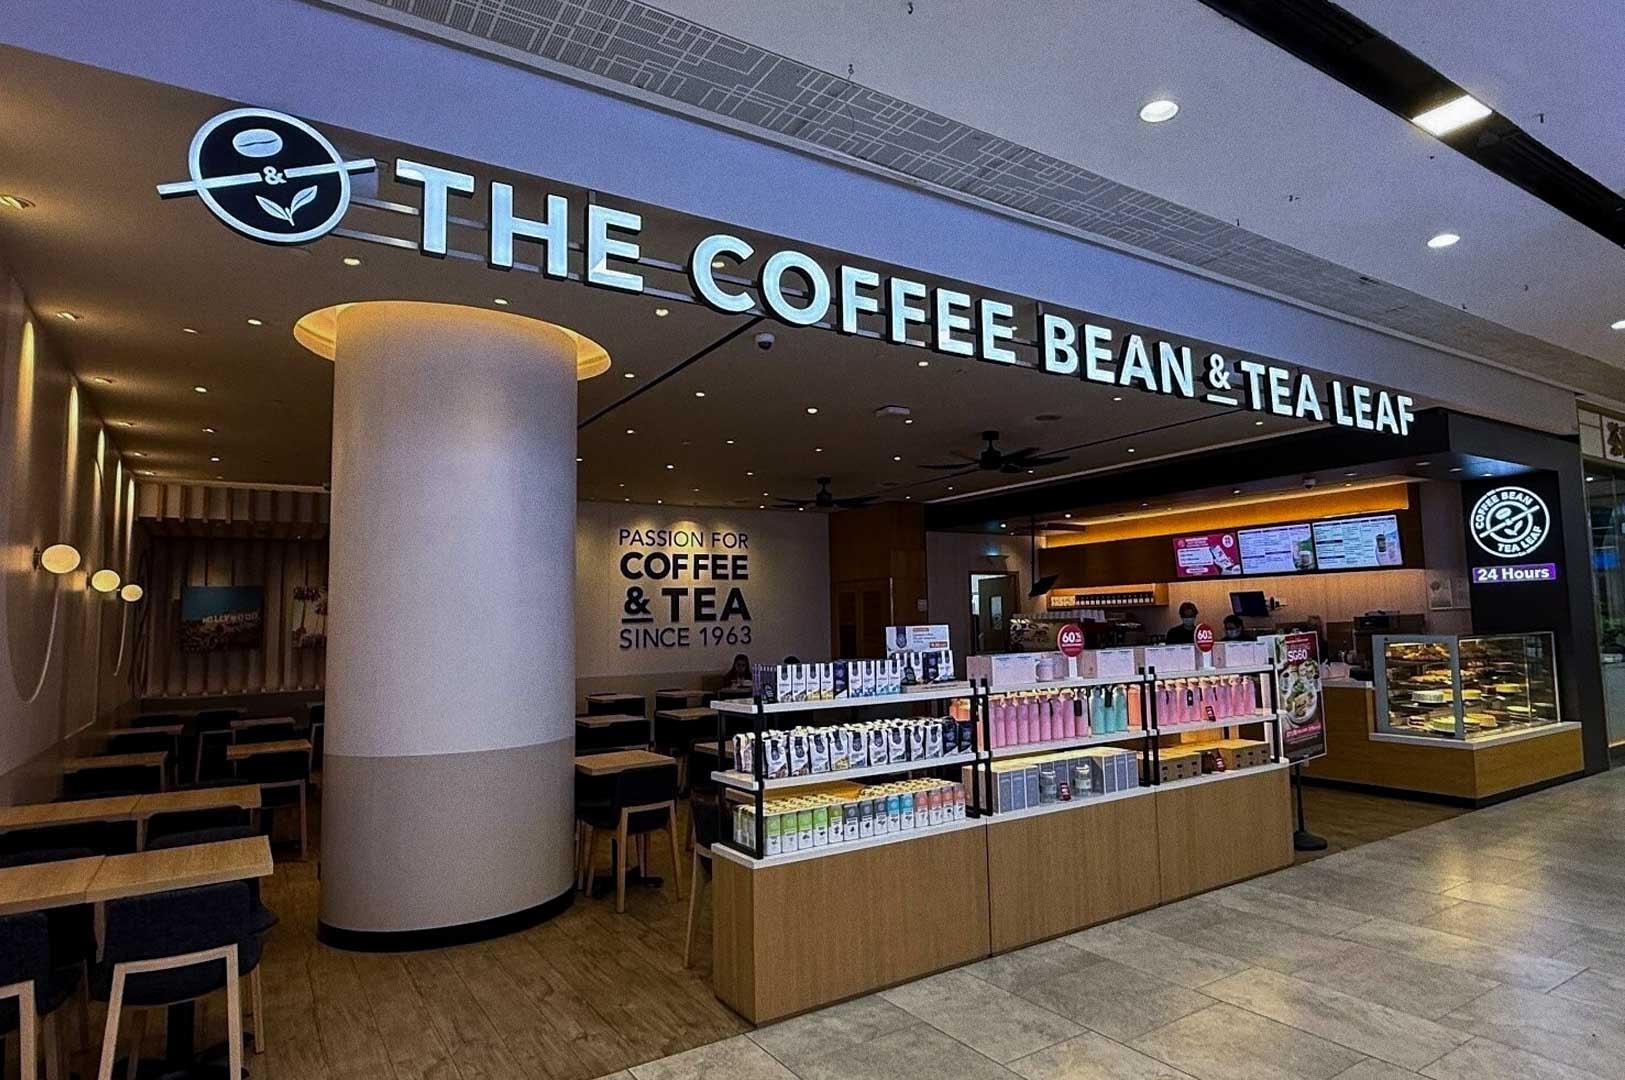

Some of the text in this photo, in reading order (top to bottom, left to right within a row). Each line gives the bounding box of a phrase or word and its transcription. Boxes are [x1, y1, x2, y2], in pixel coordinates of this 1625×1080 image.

[263, 166, 287, 185] &
[395, 158, 644, 293] THE
[692, 234, 1016, 364] COFFEE
[1044, 313, 1194, 398] BEAN
[1240, 360, 1323, 421] TEA
[1333, 381, 1414, 436] LEAF
[1475, 491, 1533, 530] COFFEE BEAN
[619, 529, 749, 549] PASSION FOR
[1497, 525, 1542, 553] TEA LEAF
[620, 552, 749, 580] COFFEE
[1478, 567, 1550, 581] 24 Hours
[622, 586, 752, 623] & TEA
[619, 626, 752, 649] SINCE 1963
